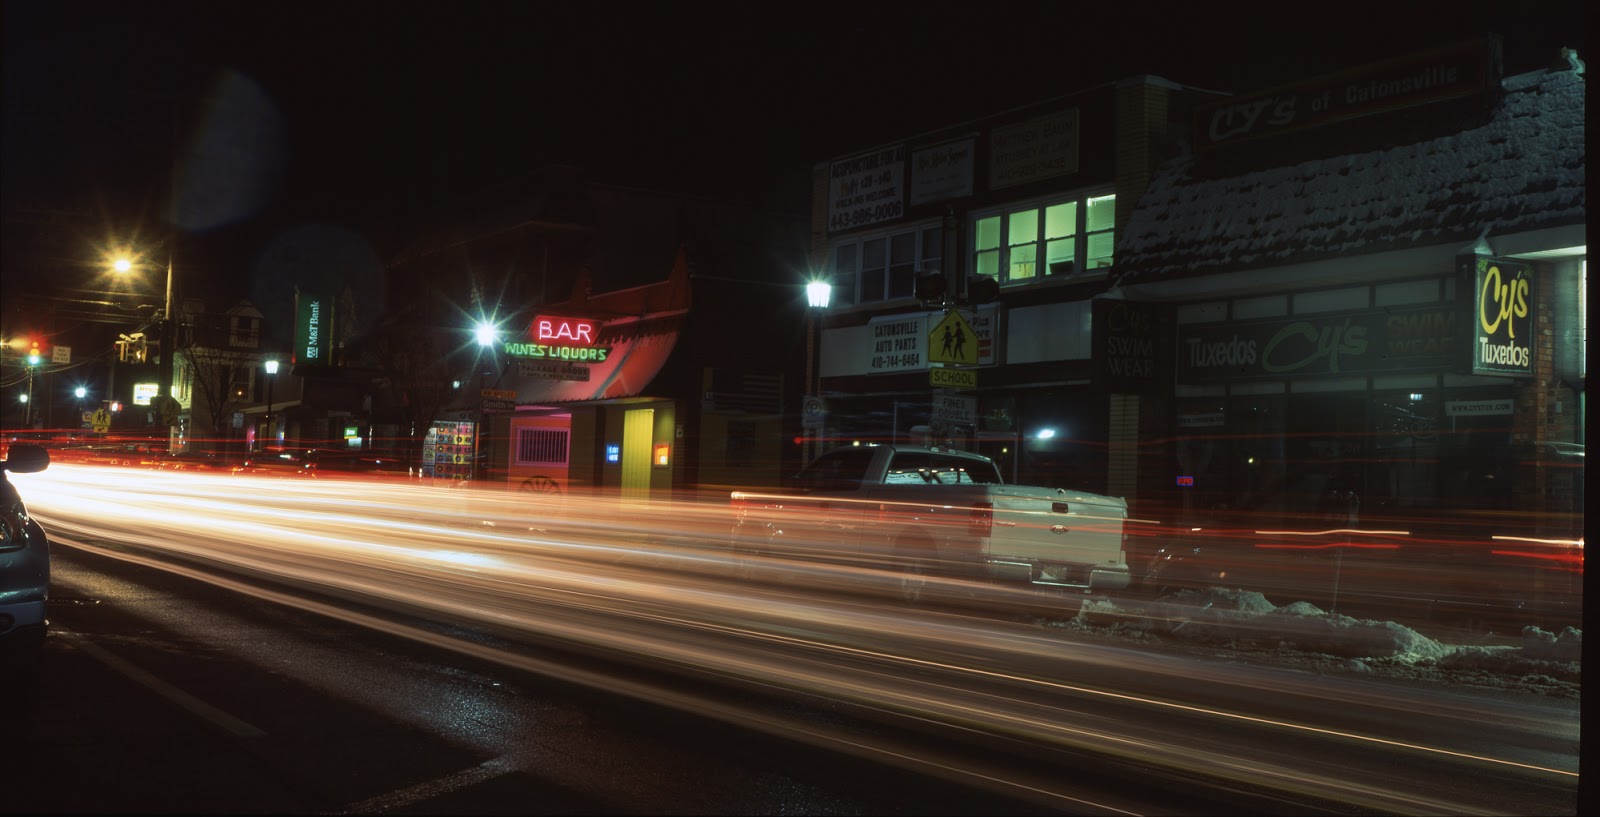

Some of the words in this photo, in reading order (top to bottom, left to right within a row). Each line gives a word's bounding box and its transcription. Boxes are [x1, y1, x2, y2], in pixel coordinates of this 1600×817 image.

[1311, 90, 1331, 112] of
[1345, 65, 1457, 105] Catonsville
[832, 152, 880, 178] ACUPUNCTURE
[865, 187, 897, 202] WELCOME
[310, 300, 320, 324] Bank
[1480, 266, 1529, 339] Cy's
[875, 321, 919, 338] CATONSVILLE
[972, 316, 989, 328] Plus
[1386, 311, 1456, 339] SWIM
[308, 324, 319, 346] M&T
[538, 321, 592, 343] BAR
[548, 346, 607, 361] LIQUORS
[875, 339, 893, 353] AUTO
[895, 337, 917, 351] PARTS
[1107, 336, 1153, 357] SWIM
[1185, 334, 1257, 368] Tuxedos
[1262, 318, 1369, 375] Cy's
[1479, 336, 1529, 367] Tuxedos
[521, 364, 558, 374] PACKAGE
[561, 366, 589, 375] GOODS
[871, 353, 920, 369] 410-744-6464
[1106, 356, 1154, 377] WEAR
[934, 371, 974, 385] SCHOOL
[483, 400, 506, 409] Smith
[943, 398, 966, 409] FINES
[992, 408, 1006, 418] 715
[938, 408, 969, 420] DOUBLE
